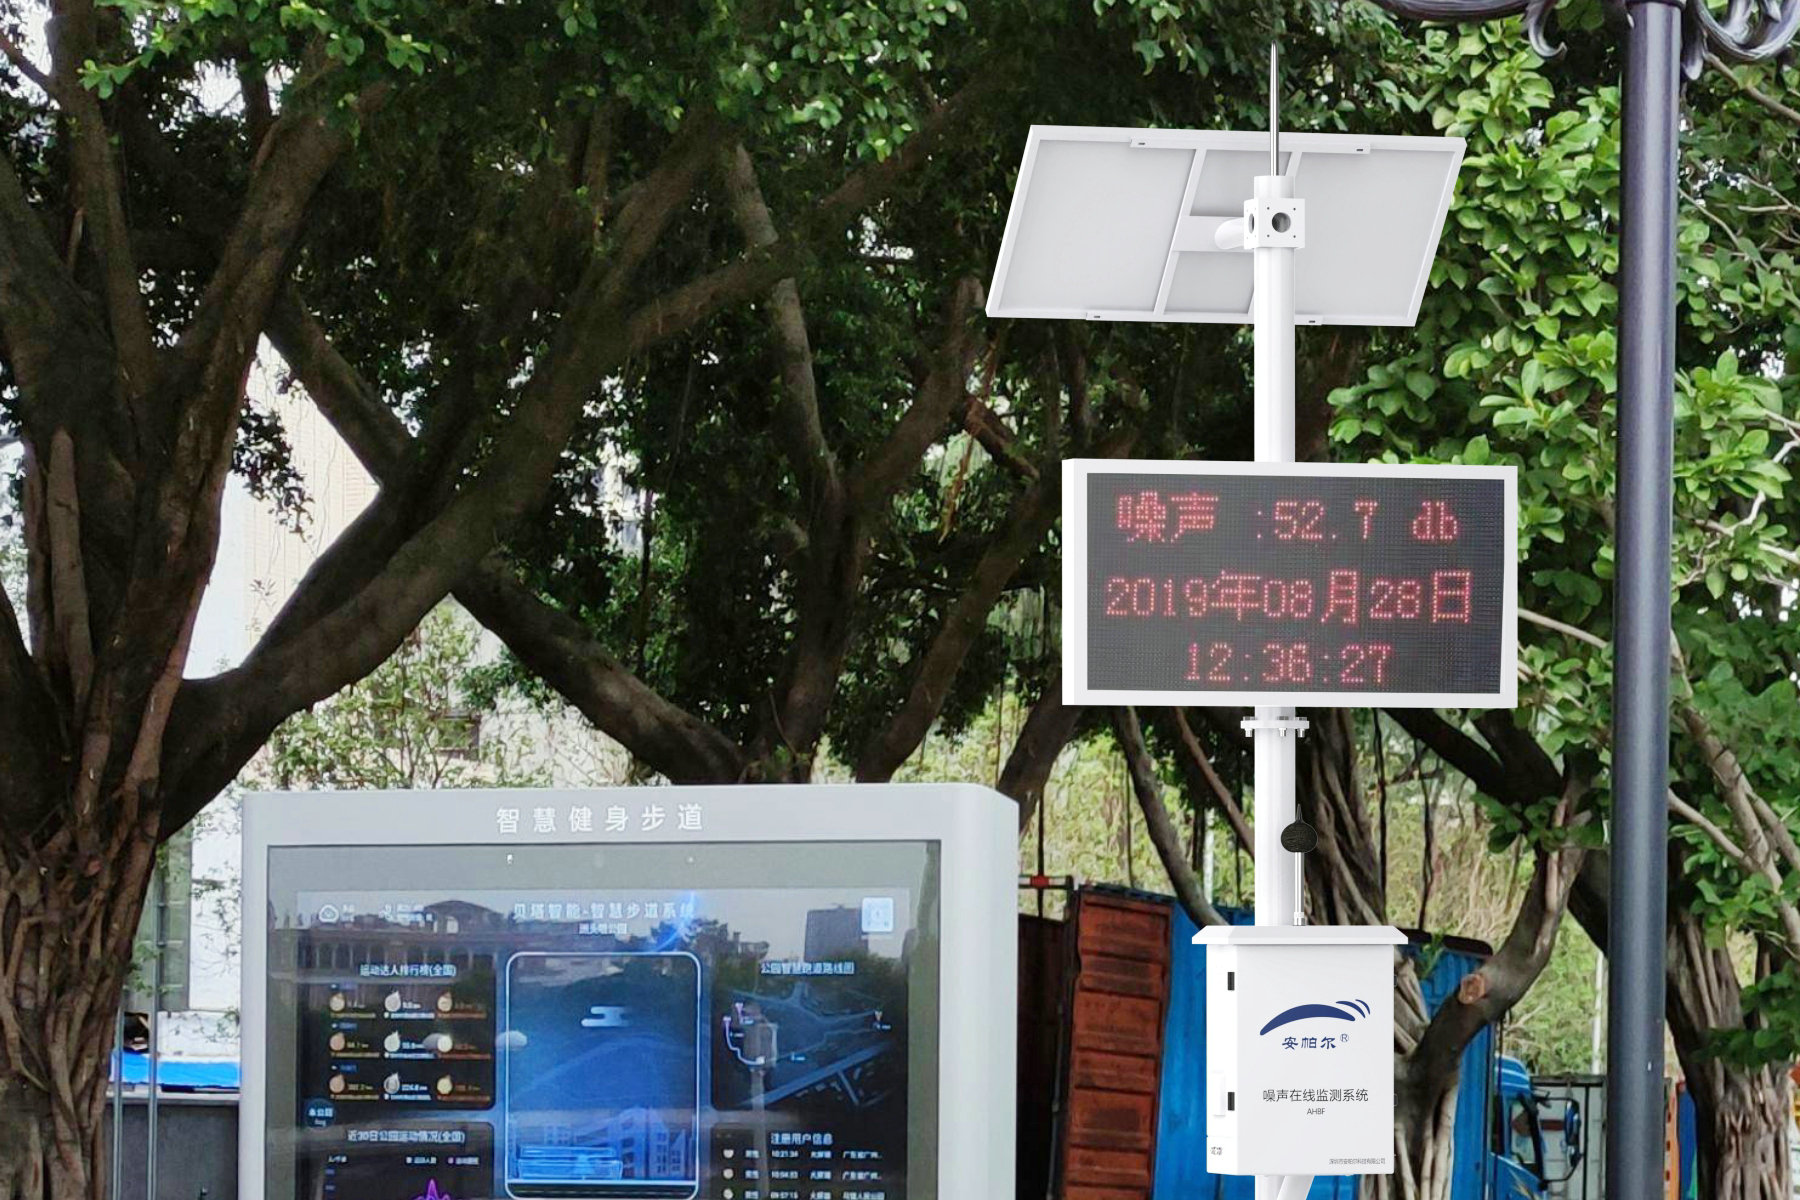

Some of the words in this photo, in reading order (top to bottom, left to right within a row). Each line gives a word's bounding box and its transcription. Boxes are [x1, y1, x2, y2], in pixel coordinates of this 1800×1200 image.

[1117, 491, 1220, 543] 噪声
[1411, 500, 1459, 541] db
[1105, 568, 1472, 624] 2019年08月28日
[1185, 642, 1393, 684] 12:36:27
[496, 803, 704, 834] 智慧健身步道
[1281, 1036, 1338, 1050] 安帕尔
[1262, 1089, 1370, 1102] 噪声在线监测系统
